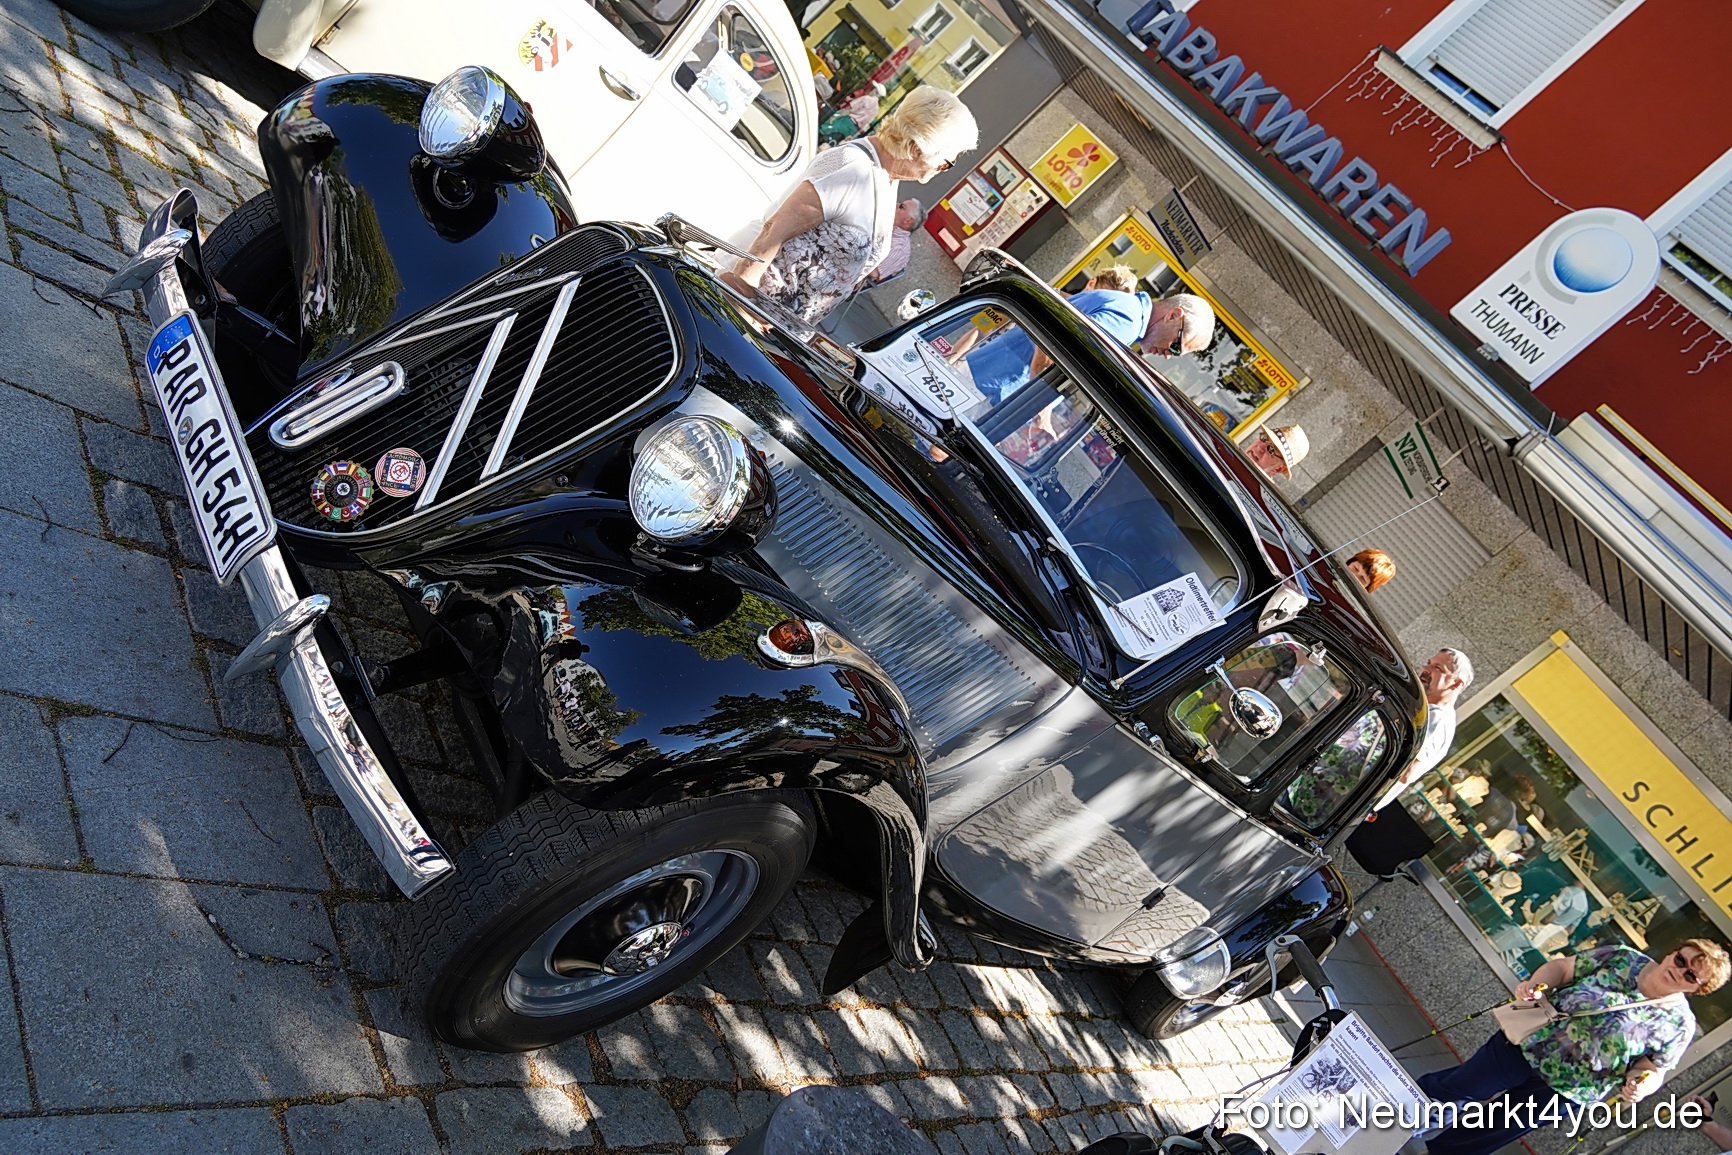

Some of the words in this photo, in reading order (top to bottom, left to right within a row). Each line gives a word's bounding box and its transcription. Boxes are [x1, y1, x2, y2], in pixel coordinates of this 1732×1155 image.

[1126, 0, 1452, 278] TABAKWAREN
[1043, 173, 1062, 194] Bayern
[1047, 154, 1083, 189] LOTTO
[1132, 231, 1151, 251] LOTTO
[1160, 219, 1185, 255] Nachrichten
[1164, 199, 1204, 256] NEUMARKTER
[984, 308, 1003, 325] ADAC
[1498, 283, 1566, 340] PRESSE
[1470, 299, 1545, 365] THUMANN
[153, 346, 161, 358] D
[157, 339, 207, 426] PAR
[1265, 365, 1287, 388] LOTTO
[186, 418, 230, 488] GH
[1109, 429, 1124, 444] nicht
[1393, 431, 1418, 459] NZ
[203, 467, 258, 565] 54H
[1622, 781, 1732, 912] SCHLI
[1345, 1025, 1358, 1041] kannt
[1350, 1020, 1368, 1038] Brigitte
[1365, 1036, 1381, 1053] Bardot
[1378, 1051, 1394, 1069] machte
[1391, 1067, 1400, 1076] die
[1397, 1074, 1410, 1087] Solex
[1407, 1085, 1419, 1098] 3800
